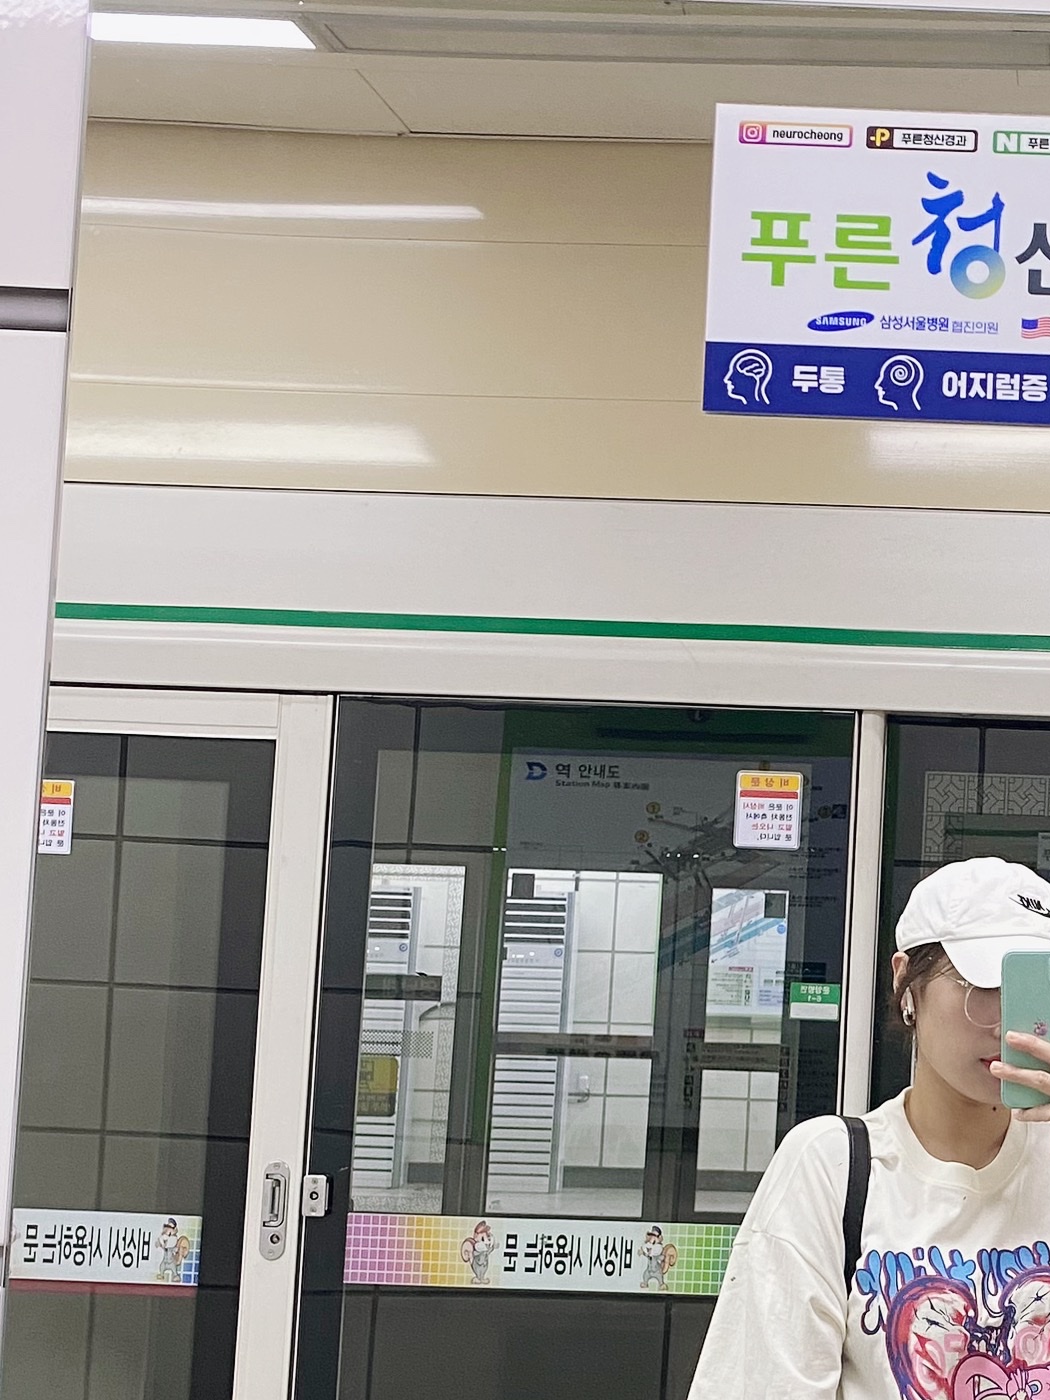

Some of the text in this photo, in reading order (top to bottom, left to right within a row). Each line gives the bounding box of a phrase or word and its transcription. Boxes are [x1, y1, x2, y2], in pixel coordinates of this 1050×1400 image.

[772, 128, 844, 143] neurocheong
[901, 132, 968, 147] 푸른청신경과
[813, 314, 869, 328] SAMSUNG
[880, 314, 999, 334] 삼성서울병원 협진의원
[792, 365, 845, 394] 두통
[942, 370, 1048, 402] 어지럼증
[555, 763, 620, 779] 역 안내도
[555, 779, 590, 788] Station
